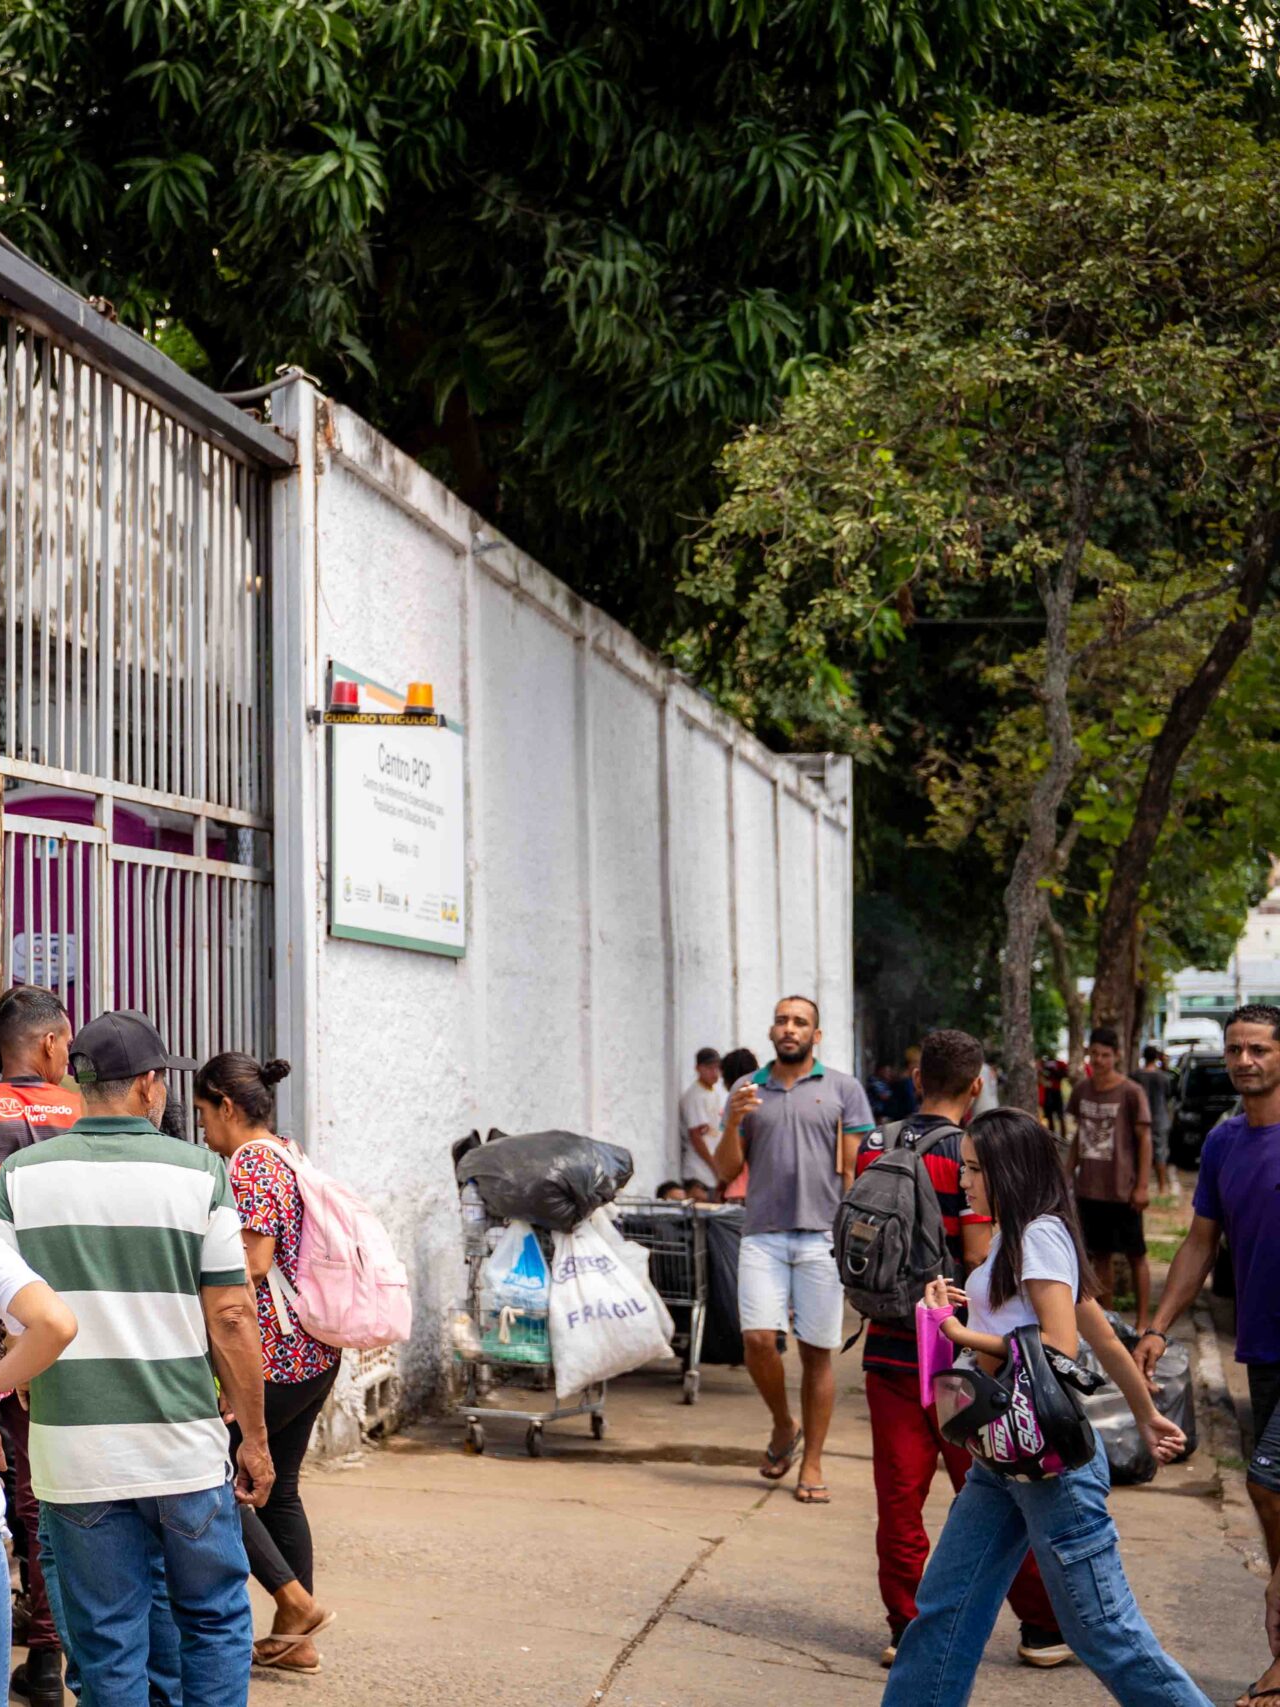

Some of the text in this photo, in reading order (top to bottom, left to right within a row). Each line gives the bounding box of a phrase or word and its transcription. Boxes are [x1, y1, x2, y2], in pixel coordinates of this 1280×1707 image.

[324, 713, 377, 724] CUIDADO
[378, 742, 431, 790] Centro POP
[24, 1104, 73, 1116] mercado
